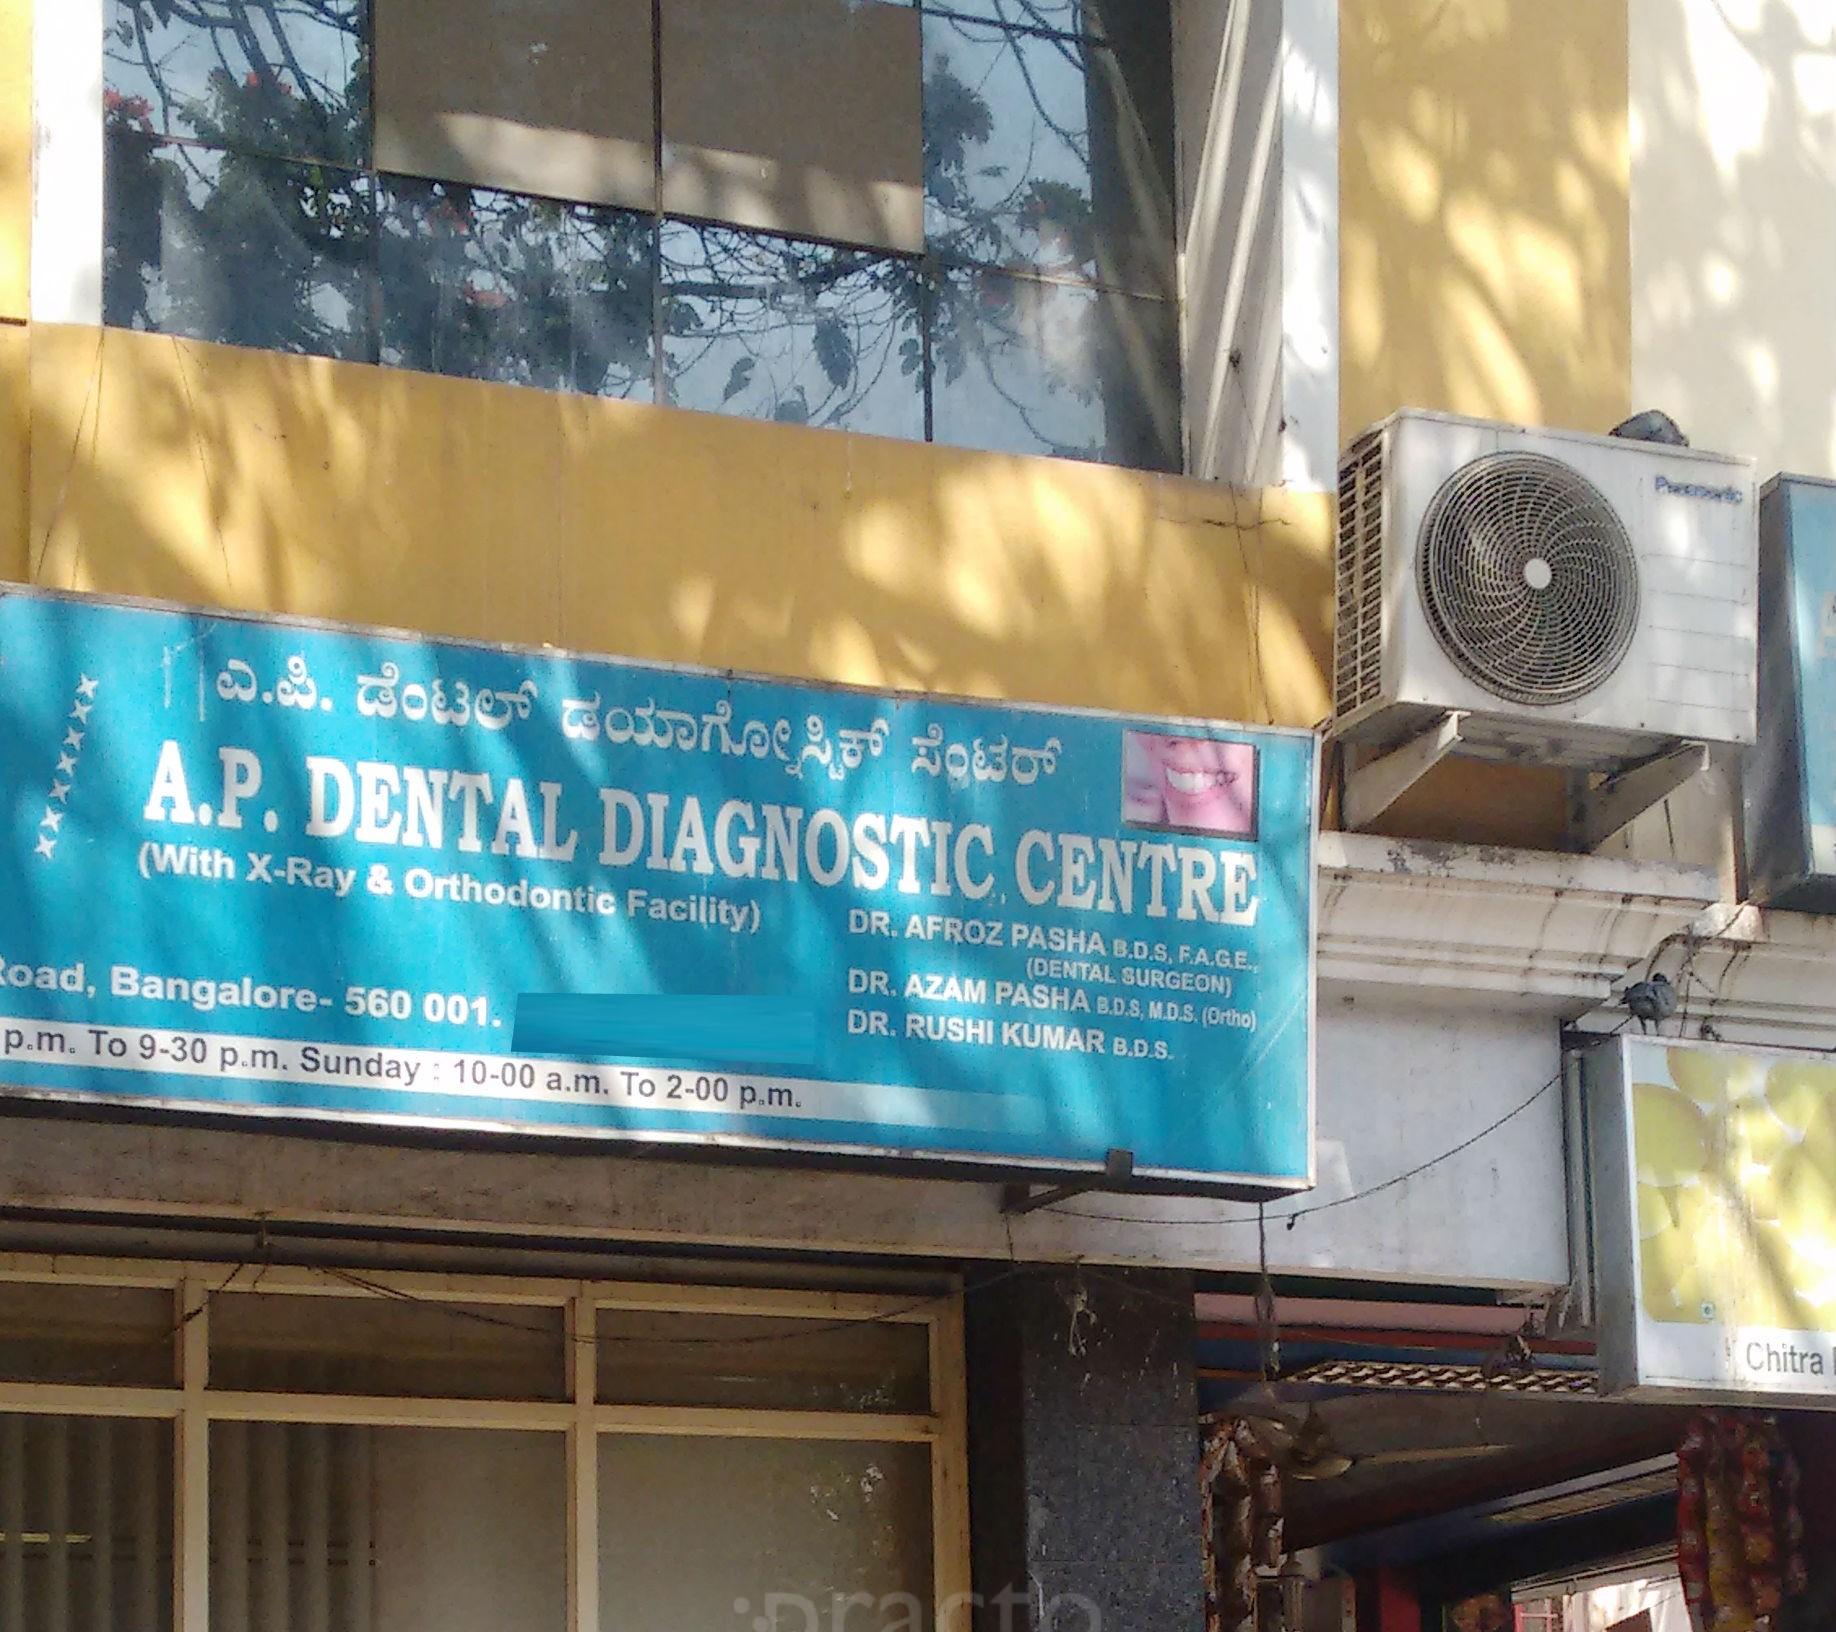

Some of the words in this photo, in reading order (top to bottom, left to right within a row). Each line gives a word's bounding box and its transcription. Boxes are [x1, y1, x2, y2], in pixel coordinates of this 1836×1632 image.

[356, 662, 538, 731] ಡೆಂಟಲ್
[143, 739, 279, 832] A.P.
[305, 756, 579, 862] DENTAL
[600, 788, 995, 897] DIAGNOSTIC
[1014, 829, 1259, 928] CENTRE
[138, 841, 236, 880] (With
[245, 851, 357, 897] X-Ray
[365, 863, 394, 896] &
[404, 867, 617, 916] Orthodontic
[627, 889, 761, 934] Facility)
[848, 908, 898, 938] DR.
[905, 914, 1003, 947] AFROZ
[1011, 923, 1107, 958] PASHA
[0, 960, 97, 999] oad,
[345, 986, 411, 1021] 560
[423, 992, 502, 1028] 001.
[848, 968, 897, 998] DR.
[904, 973, 987, 1006] AZAM
[994, 980, 1091, 1015] PASHA
[1202, 1007, 1257, 1029] (Ortho)
[1026, 956, 1117, 984] (DENTAL
[1121, 966, 1233, 998] SURGEON)
[847, 1009, 896, 1038] DR.
[905, 1014, 994, 1046] RUSHI
[1001, 1021, 1106, 1055] KUMAR
[4, 1028, 76, 1056] p.m.
[89, 1029, 127, 1057] To
[139, 1034, 207, 1063] 9-30
[220, 1046, 288, 1071] p.m.
[300, 1046, 420, 1086] Sunday
[453, 1059, 536, 1088] 10-00
[546, 1068, 609, 1095] a.m.
[620, 1071, 656, 1098] To
[666, 1074, 729, 1103] 2-00
[738, 1083, 803, 1110] p.m.
[1746, 1342, 1824, 1376] Chitra
